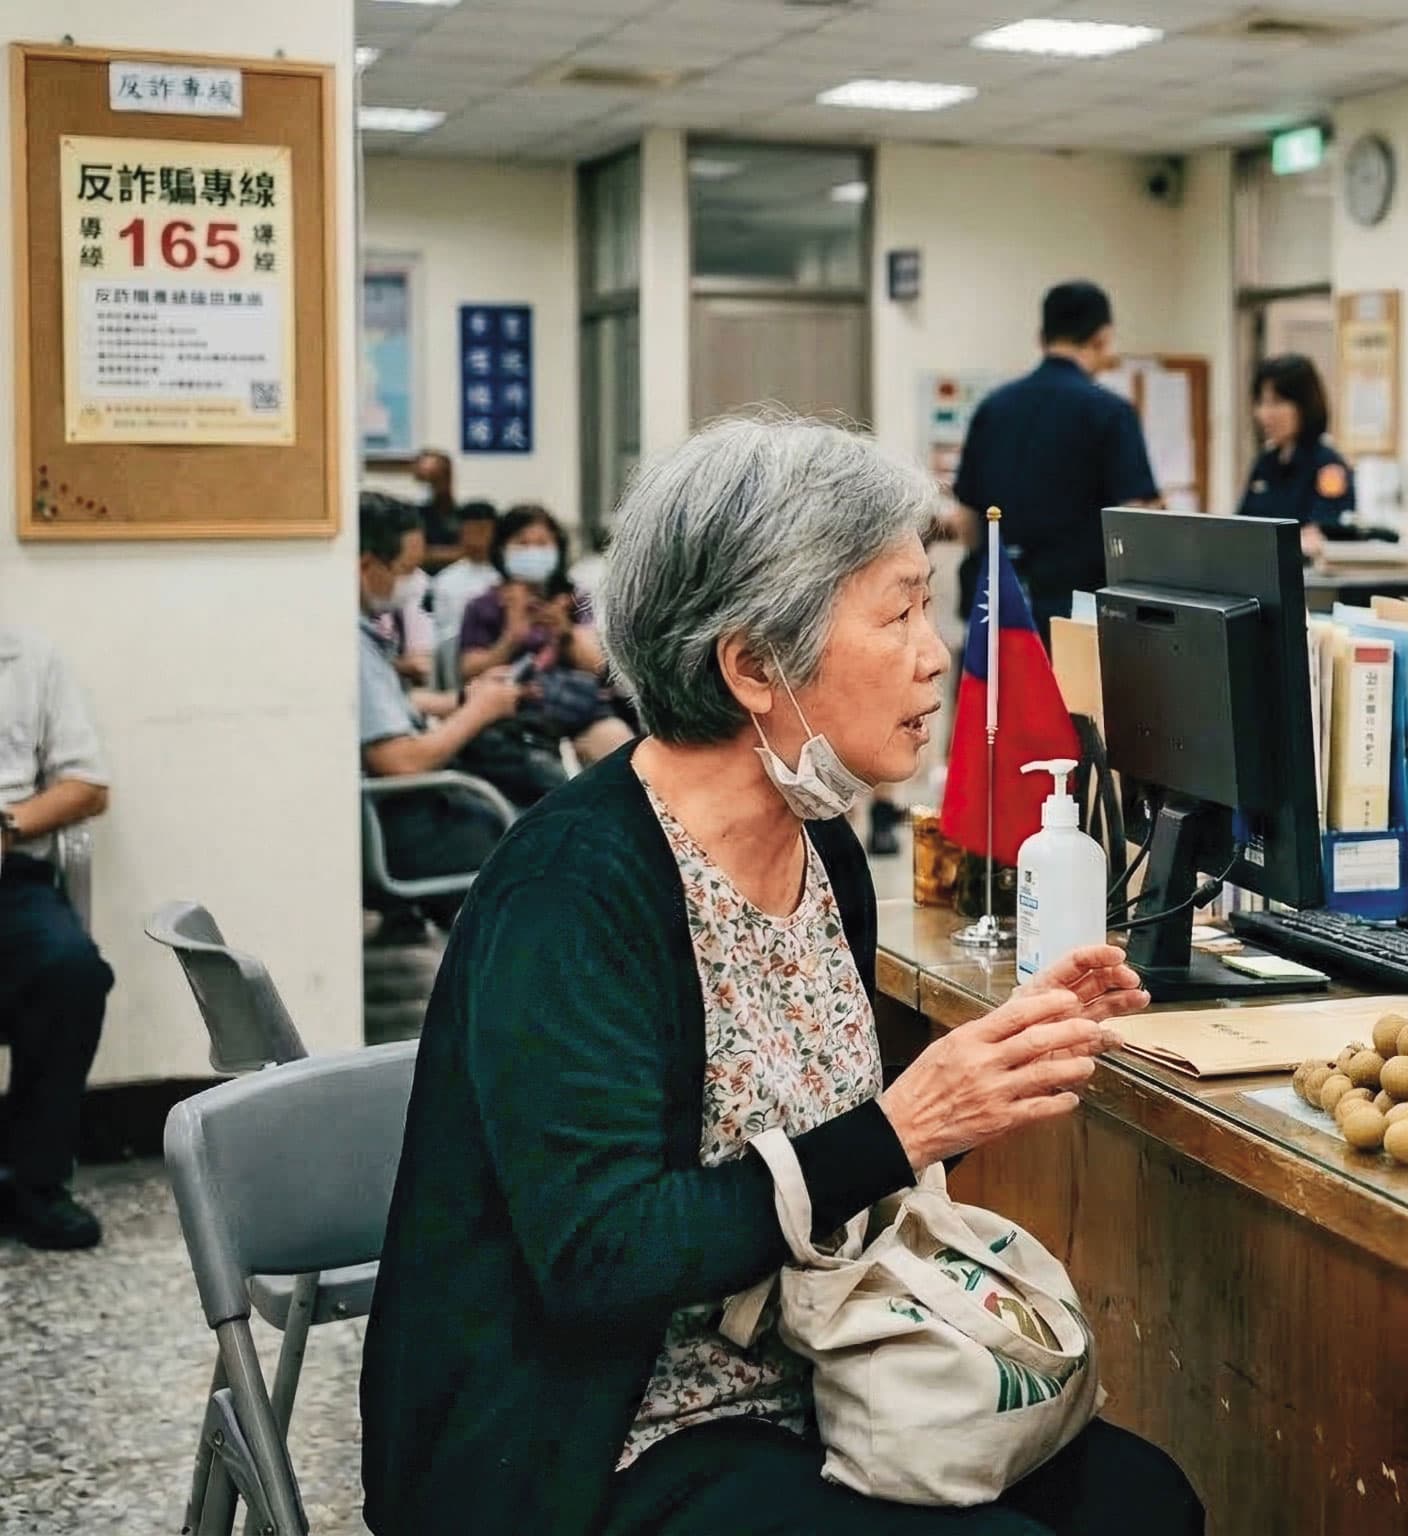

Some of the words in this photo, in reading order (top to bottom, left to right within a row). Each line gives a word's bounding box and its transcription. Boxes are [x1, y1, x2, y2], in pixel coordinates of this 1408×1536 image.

[78, 164, 276, 208] 反詐騙專線
[119, 218, 240, 269] 165
